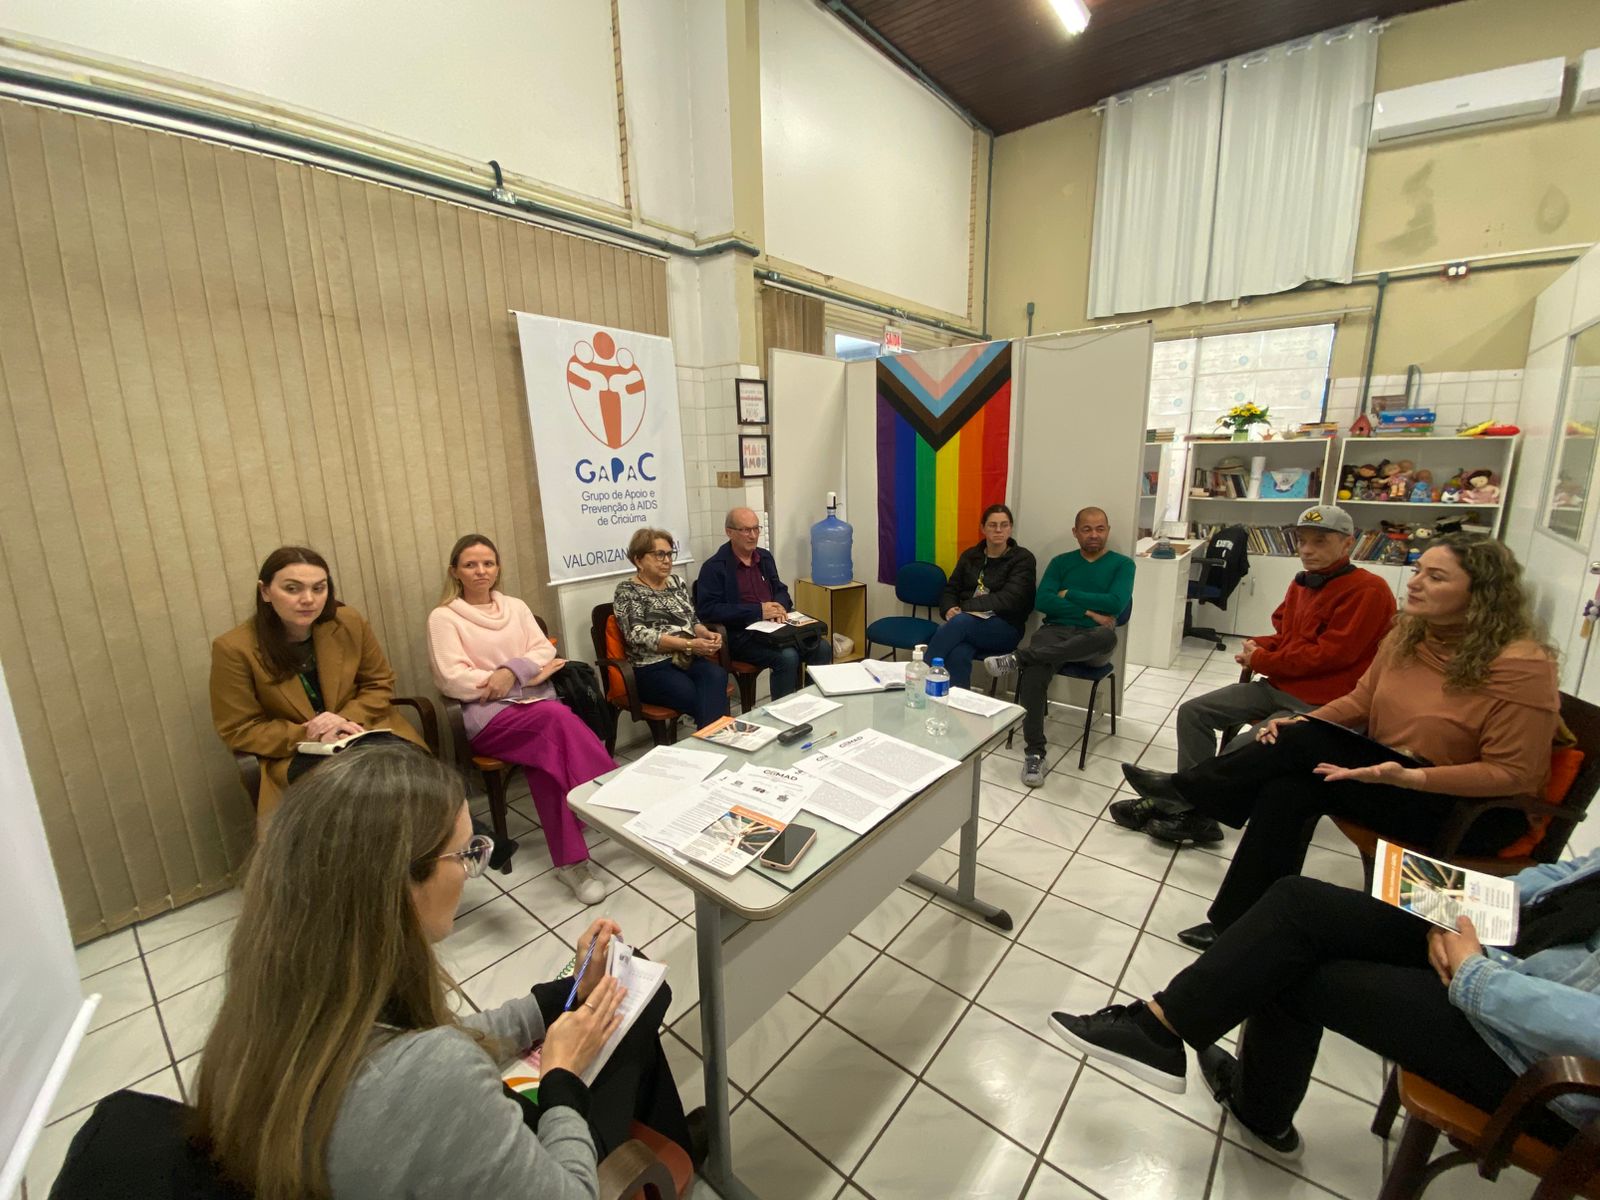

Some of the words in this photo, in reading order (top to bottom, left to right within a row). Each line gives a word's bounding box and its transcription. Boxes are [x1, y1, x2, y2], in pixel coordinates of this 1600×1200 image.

[743, 457, 766, 469] AMOR
[581, 490, 610, 502] Grupo
[612, 490, 623, 499] de
[625, 489, 648, 501] Apoio
[649, 490, 656, 498] e
[581, 502, 628, 514] Prevenção
[637, 500, 658, 510] AIDS
[597, 516, 609, 526] de
[610, 514, 647, 525] Criciúma
[563, 547, 630, 568] VALORIZAN
